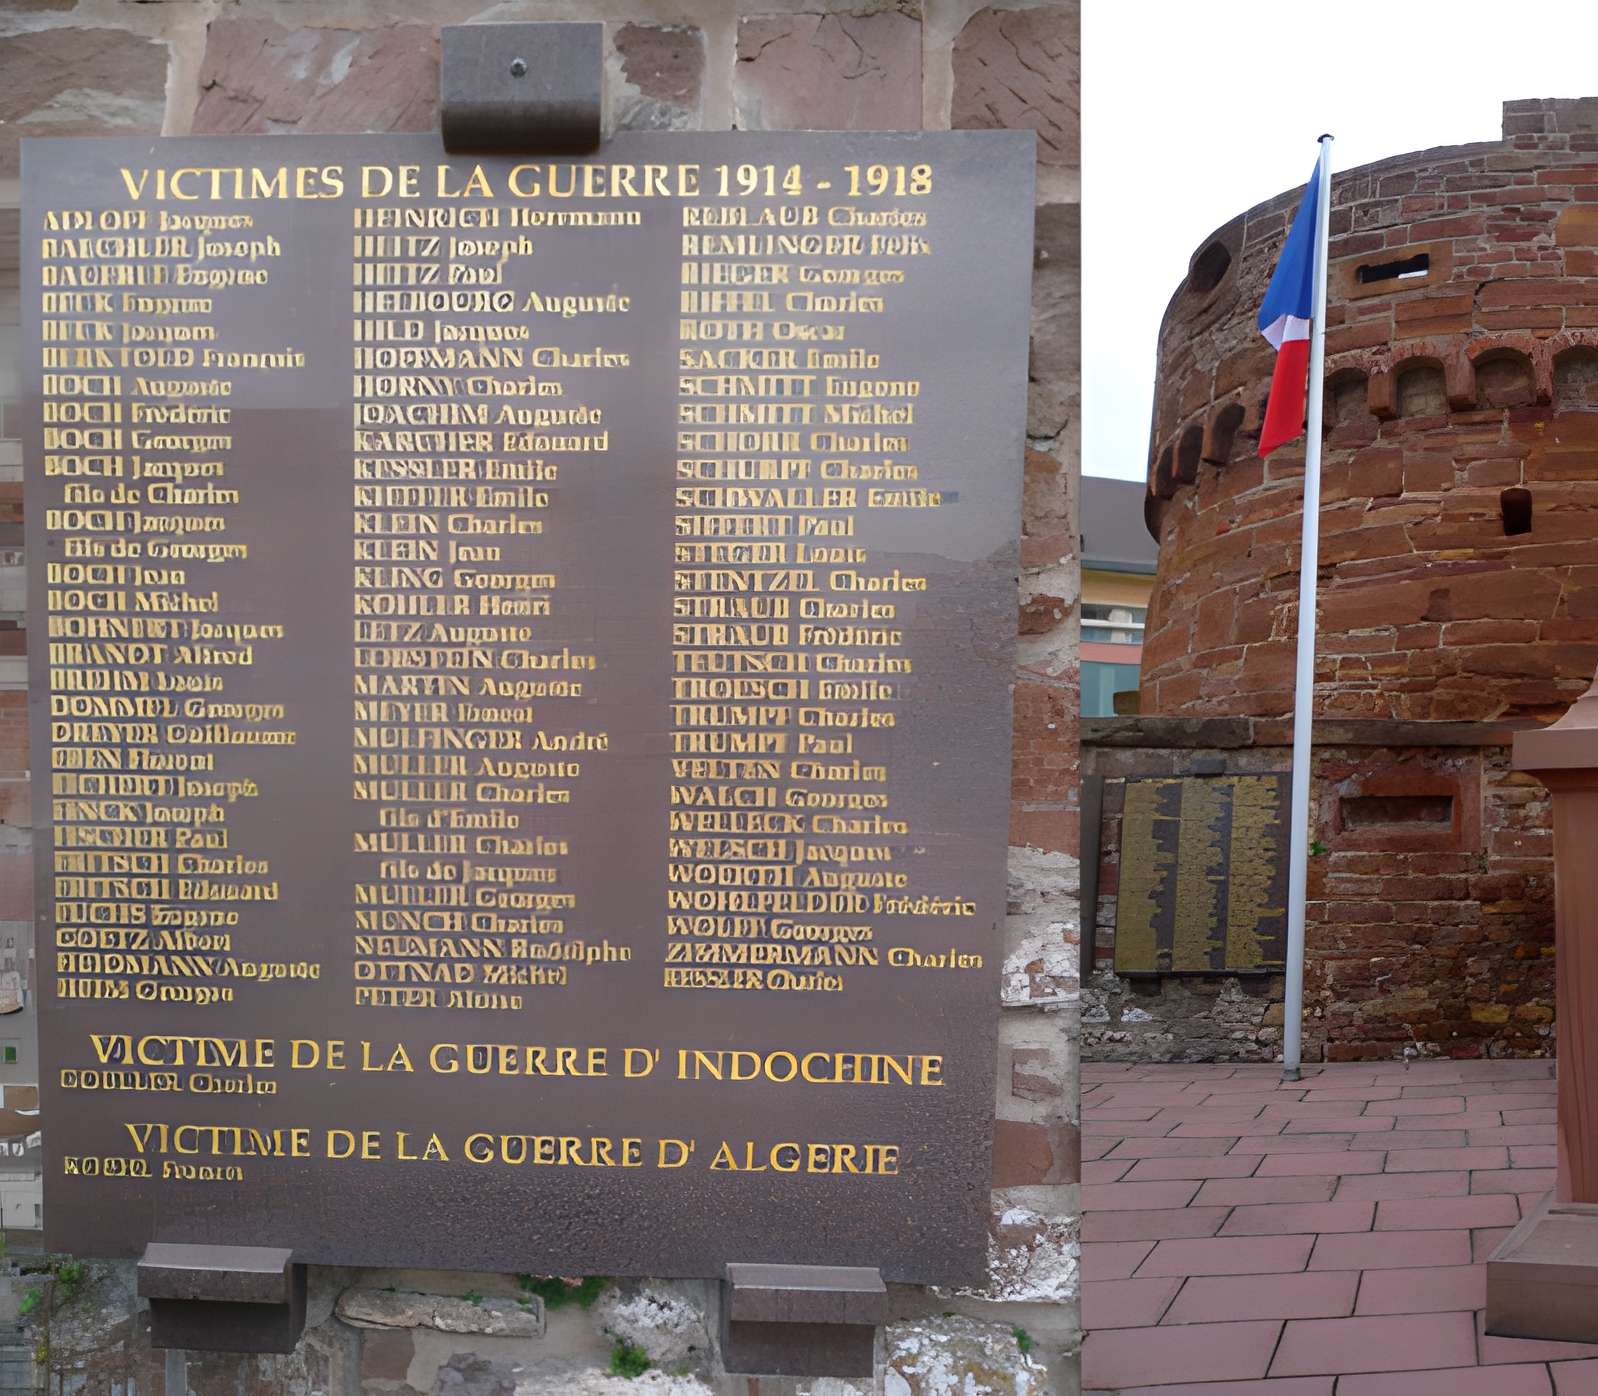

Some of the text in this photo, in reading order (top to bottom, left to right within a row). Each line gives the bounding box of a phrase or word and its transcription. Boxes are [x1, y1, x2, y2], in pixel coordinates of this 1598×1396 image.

[120, 163, 934, 201] VICTIMES DE LA GUERRE 1914 - 1918
[89, 1034, 945, 1085] VICTIME DE LA GUERRE D' INDOCHINE
[126, 1124, 900, 1175] VICTIME DE LA GUERRE D' ALGERIE
